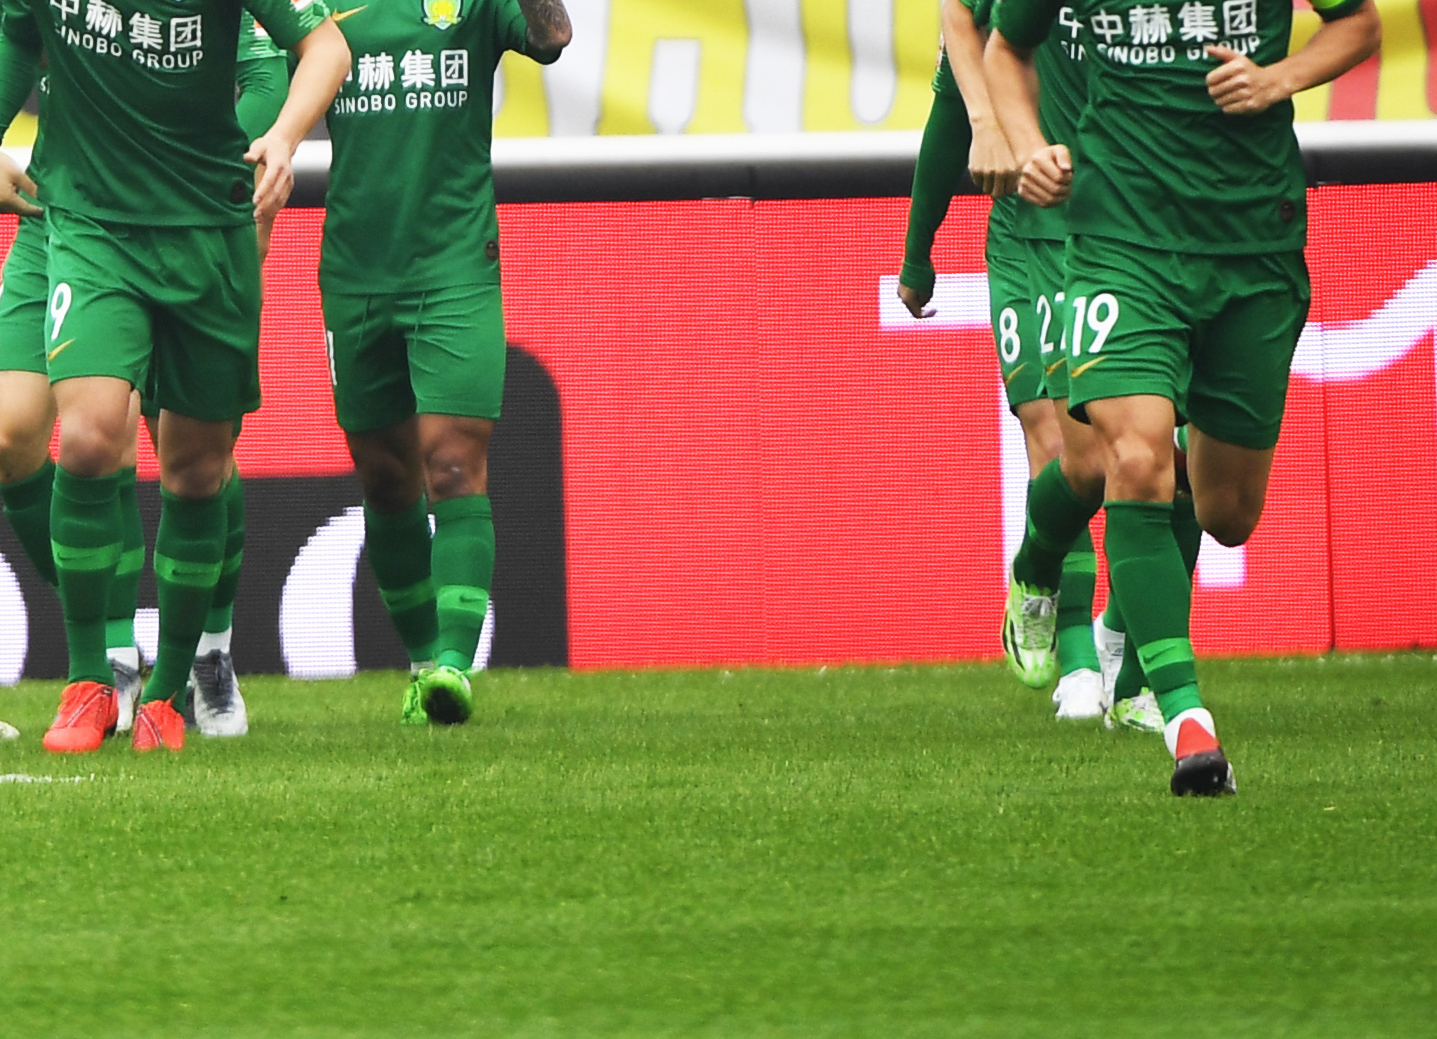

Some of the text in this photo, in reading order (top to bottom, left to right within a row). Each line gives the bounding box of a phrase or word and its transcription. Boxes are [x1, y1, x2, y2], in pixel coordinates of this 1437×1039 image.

[132, 48, 204, 69] GROUP
[338, 48, 469, 93] 赫集团
[334, 90, 469, 115] SINOBO GROUP
[50, 282, 73, 342] 9
[999, 306, 1021, 363] 8
[1071, 293, 1120, 357] 19
